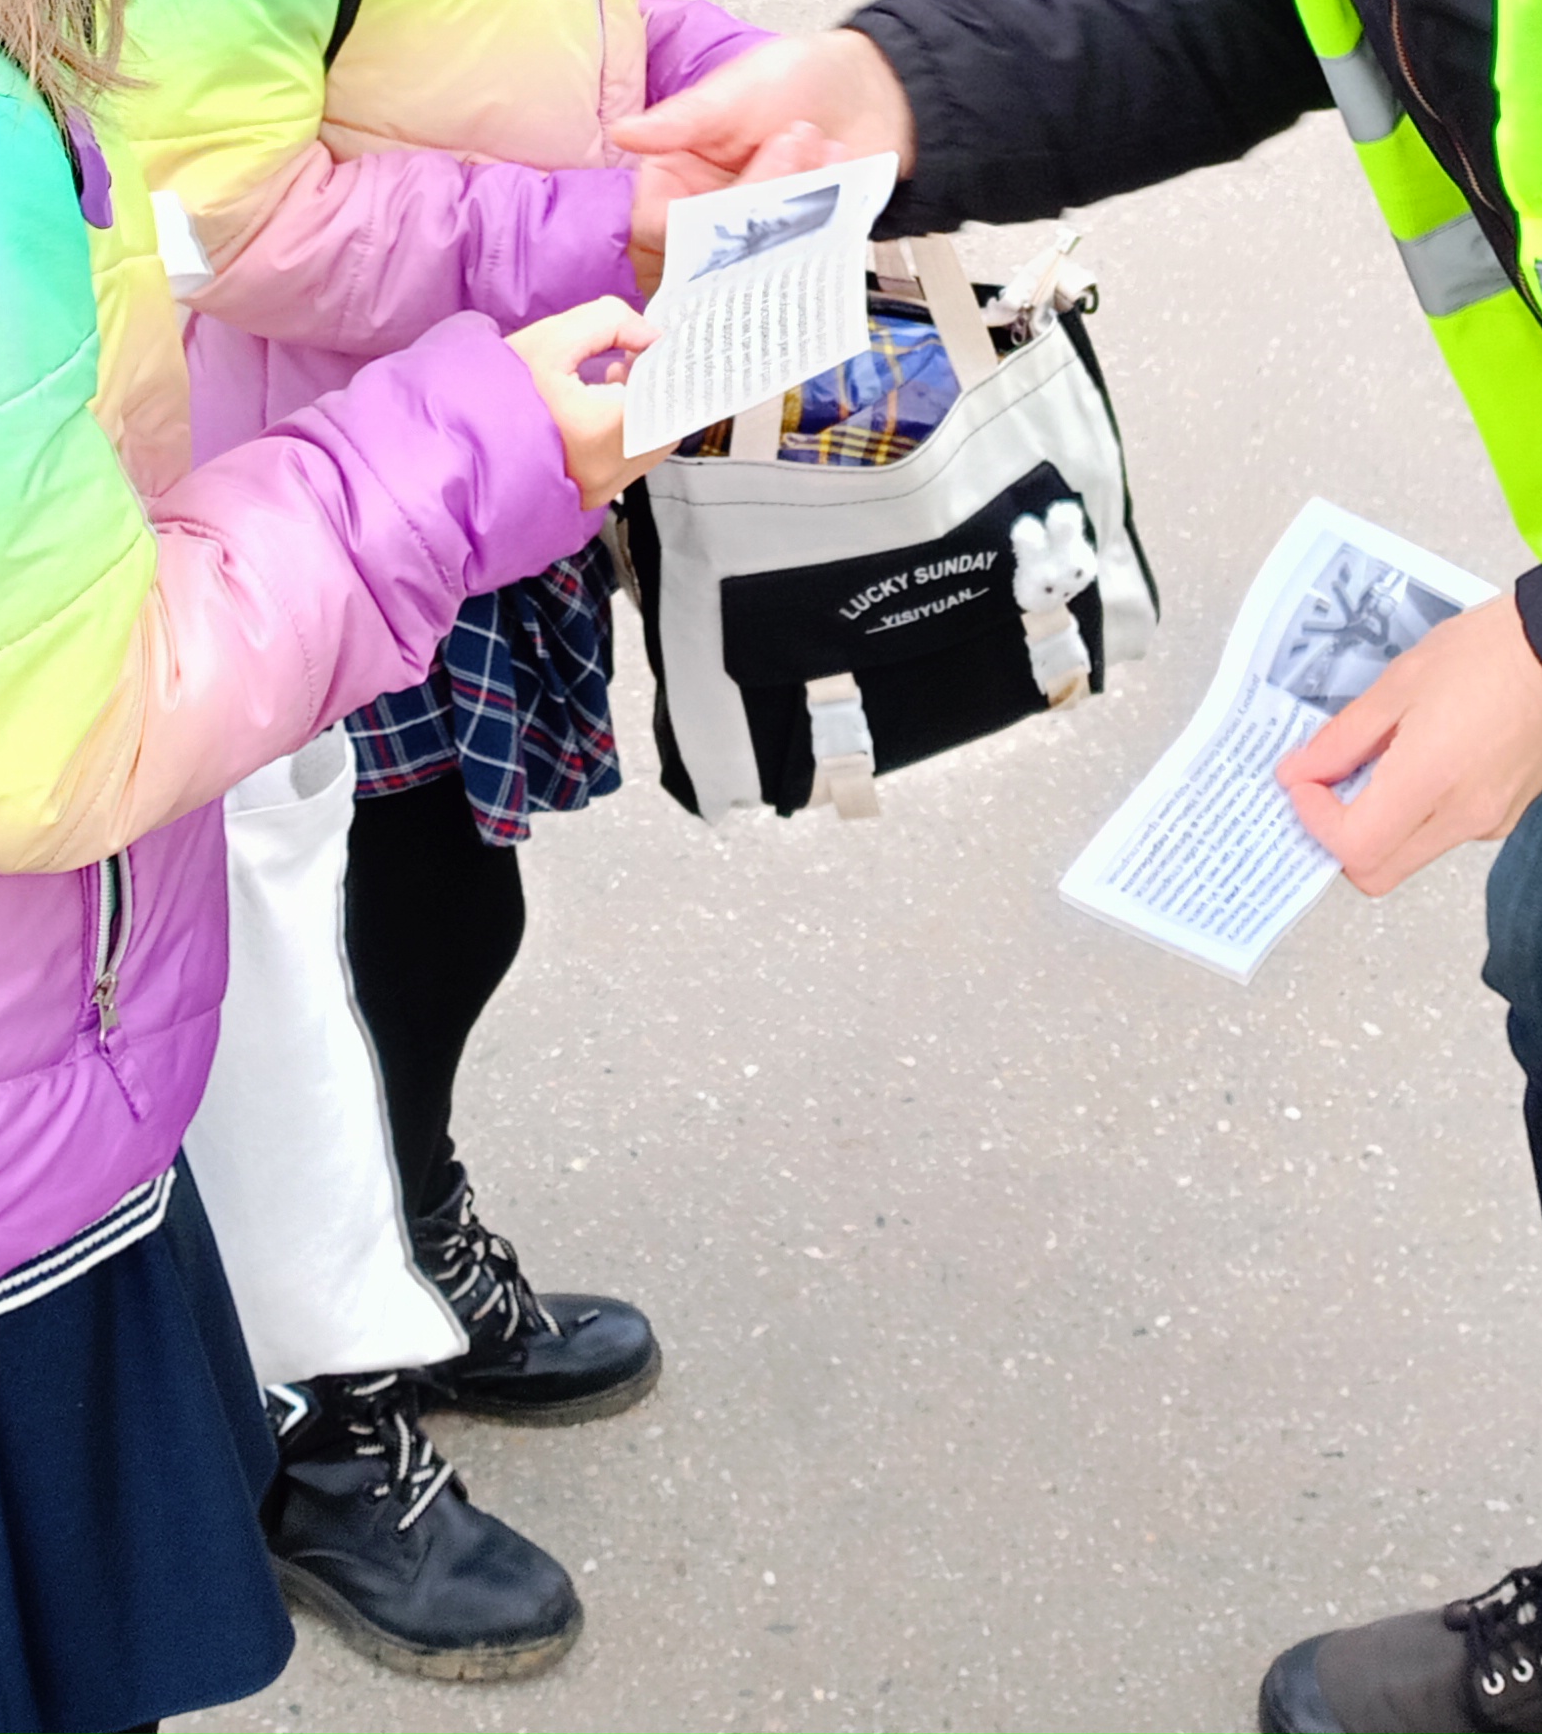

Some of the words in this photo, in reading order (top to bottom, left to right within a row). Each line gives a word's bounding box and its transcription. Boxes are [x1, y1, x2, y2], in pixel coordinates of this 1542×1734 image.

[838, 572, 908, 620] LUCKY
[913, 551, 998, 585] SUNDAY
[879, 587, 973, 626] YISIYUAN
